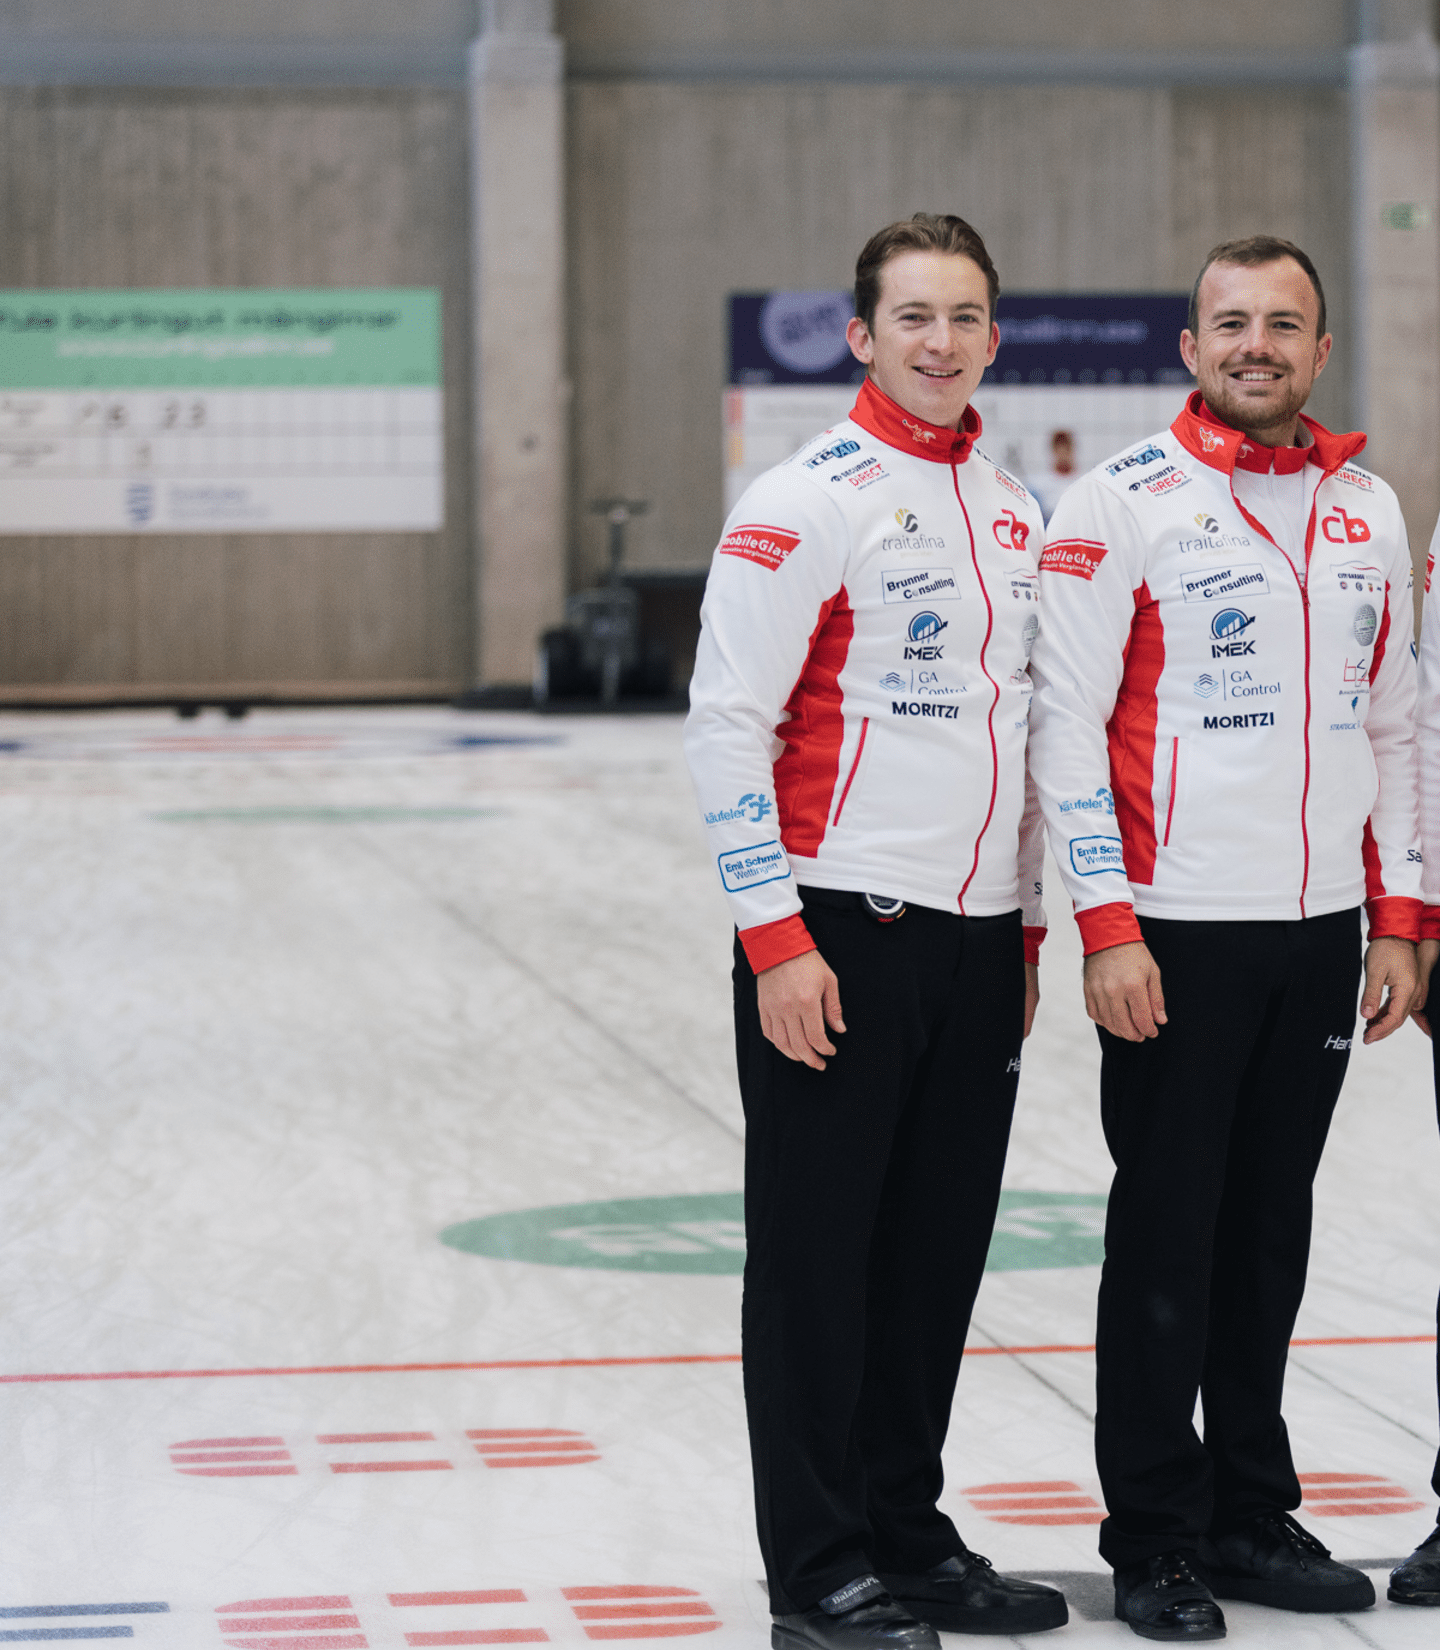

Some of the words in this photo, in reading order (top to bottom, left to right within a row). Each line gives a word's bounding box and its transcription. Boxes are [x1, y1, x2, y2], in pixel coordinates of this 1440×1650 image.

[882, 534, 946, 551] traitafina
[1179, 534, 1251, 553] traitafina
[886, 572, 930, 592] Brunner
[902, 578, 955, 599] Consulting
[1186, 570, 1231, 592] Brunner
[1203, 573, 1264, 598] Consulting
[903, 645, 945, 660] IMEK
[1211, 640, 1256, 658] IMEK
[918, 671, 939, 684] GA
[1230, 670, 1252, 683] GA
[1231, 682, 1281, 697] Control
[891, 701, 959, 719] MORITZI
[1203, 712, 1275, 729] MORITZI
[1077, 847, 1098, 867] Emil
[725, 861, 744, 883] Emil
[744, 850, 782, 868] Schmid
[733, 862, 778, 880] Wettingen
